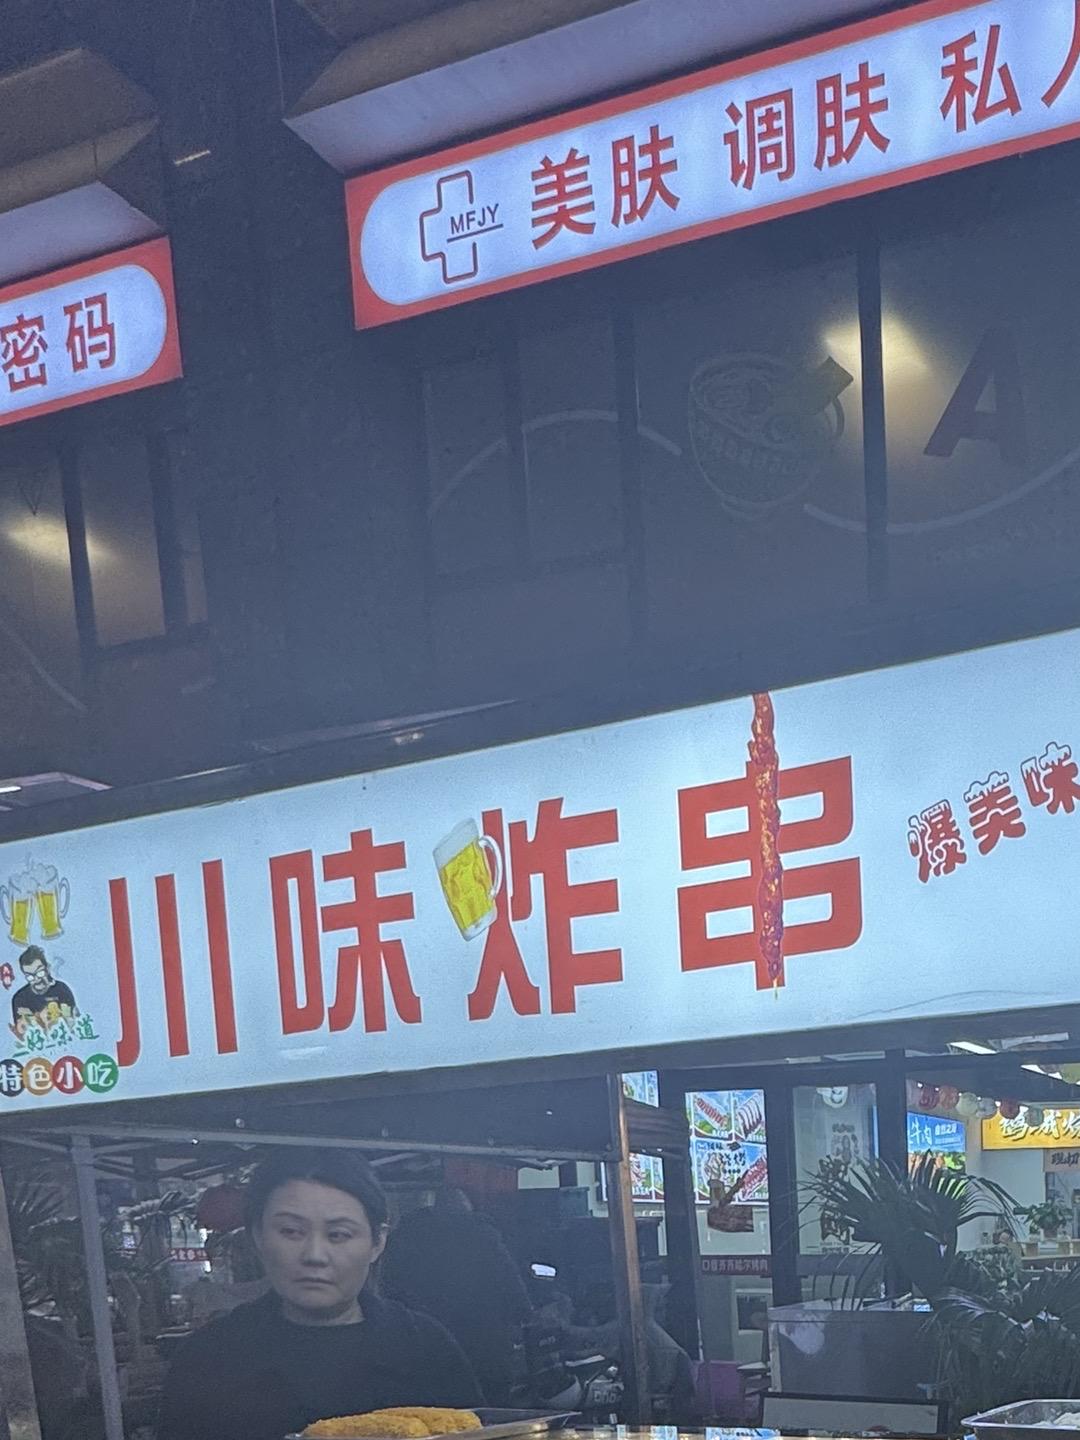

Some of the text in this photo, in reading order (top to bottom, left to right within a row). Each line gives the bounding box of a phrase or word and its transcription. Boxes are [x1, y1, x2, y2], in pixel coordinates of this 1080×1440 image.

[529, 125, 681, 250] 美肤
[723, 61, 890, 191] 调肤
[449, 203, 501, 235] MFJY
[0, 292, 118, 392] 密码
[108, 755, 862, 1067] 川味炸串
[0, 1060, 114, 1092] 特色小吃
